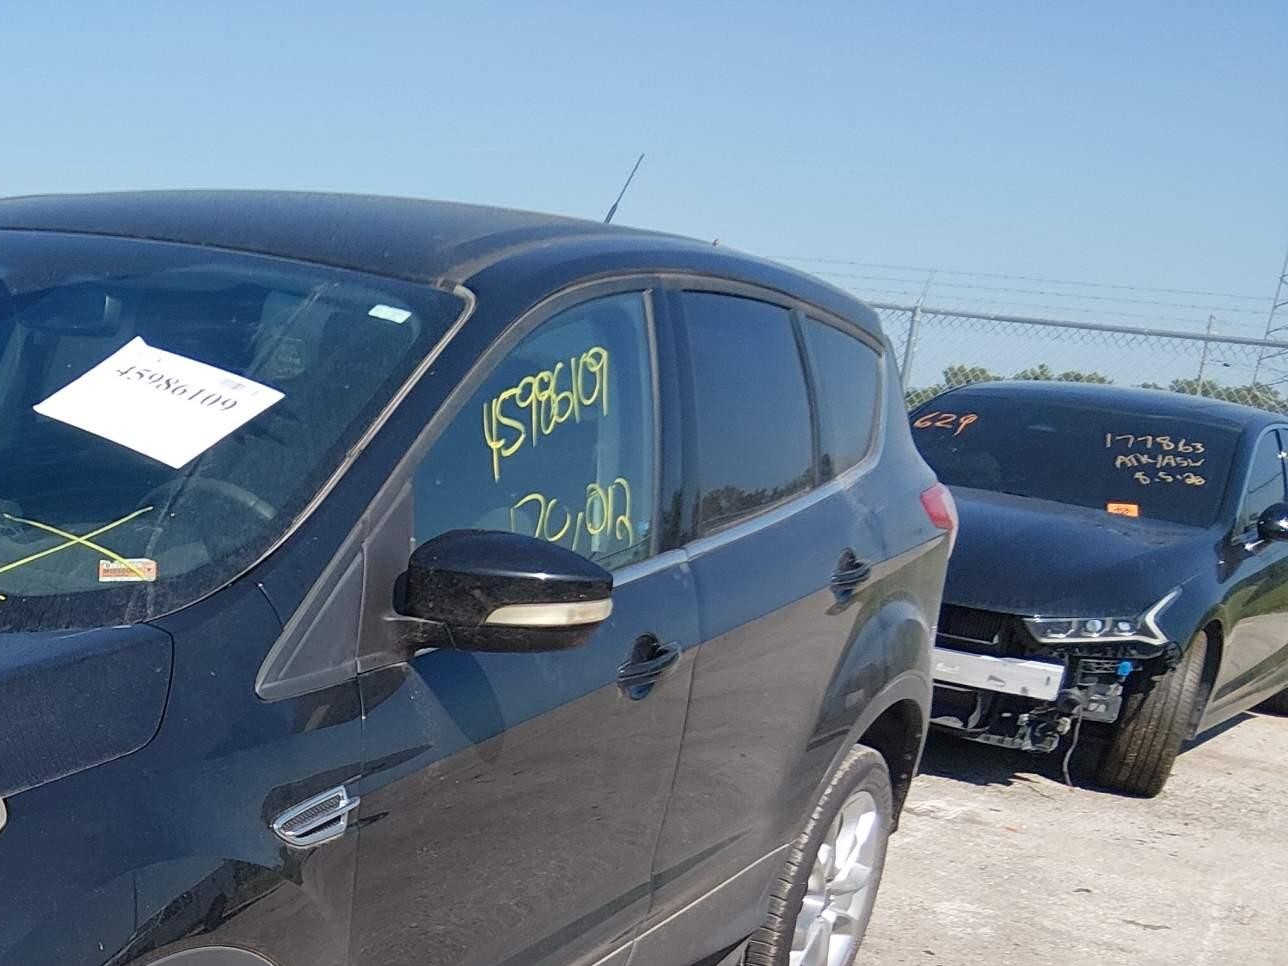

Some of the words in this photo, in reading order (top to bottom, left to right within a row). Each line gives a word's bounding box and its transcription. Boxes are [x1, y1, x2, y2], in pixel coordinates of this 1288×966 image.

[116, 365, 238, 412] 45986109
[482, 346, 609, 483] 45986109
[1105, 432, 1206, 454] 177863
